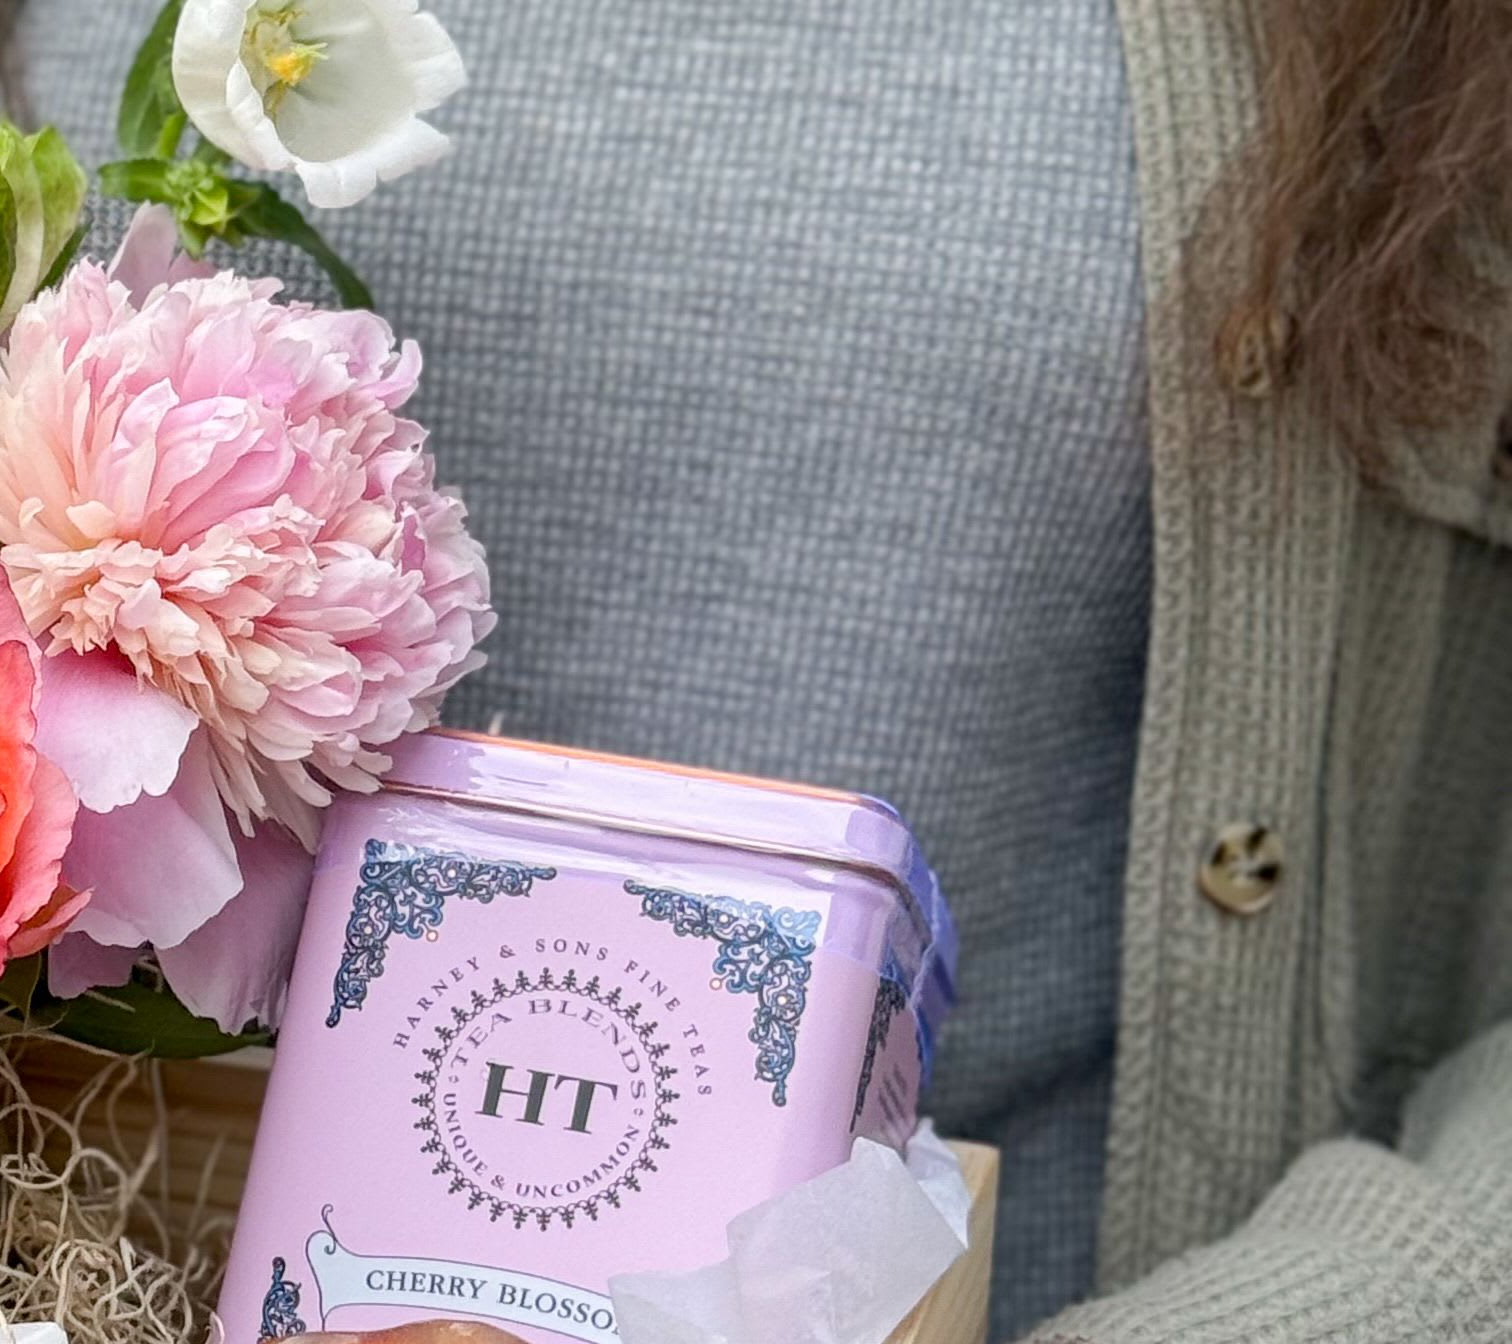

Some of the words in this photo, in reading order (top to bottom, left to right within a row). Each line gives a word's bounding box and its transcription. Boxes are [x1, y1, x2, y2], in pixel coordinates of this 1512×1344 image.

[392, 956, 480, 1049] HARNEY
[499, 944, 516, 959] &
[535, 938, 609, 961] SONS
[624, 960, 681, 1012] FINE
[683, 1024, 713, 1096] TEAS
[450, 1012, 513, 1069] TEA
[528, 998, 647, 1100] BLENDS
[442, 1092, 489, 1177] UNIQUE
[490, 1174, 507, 1191] &
[515, 1124, 641, 1199] UNCOMMON
[474, 1060, 619, 1136] HT
[365, 1269, 488, 1300] CHERRY
[496, 1282, 621, 1336] BLOSSO
